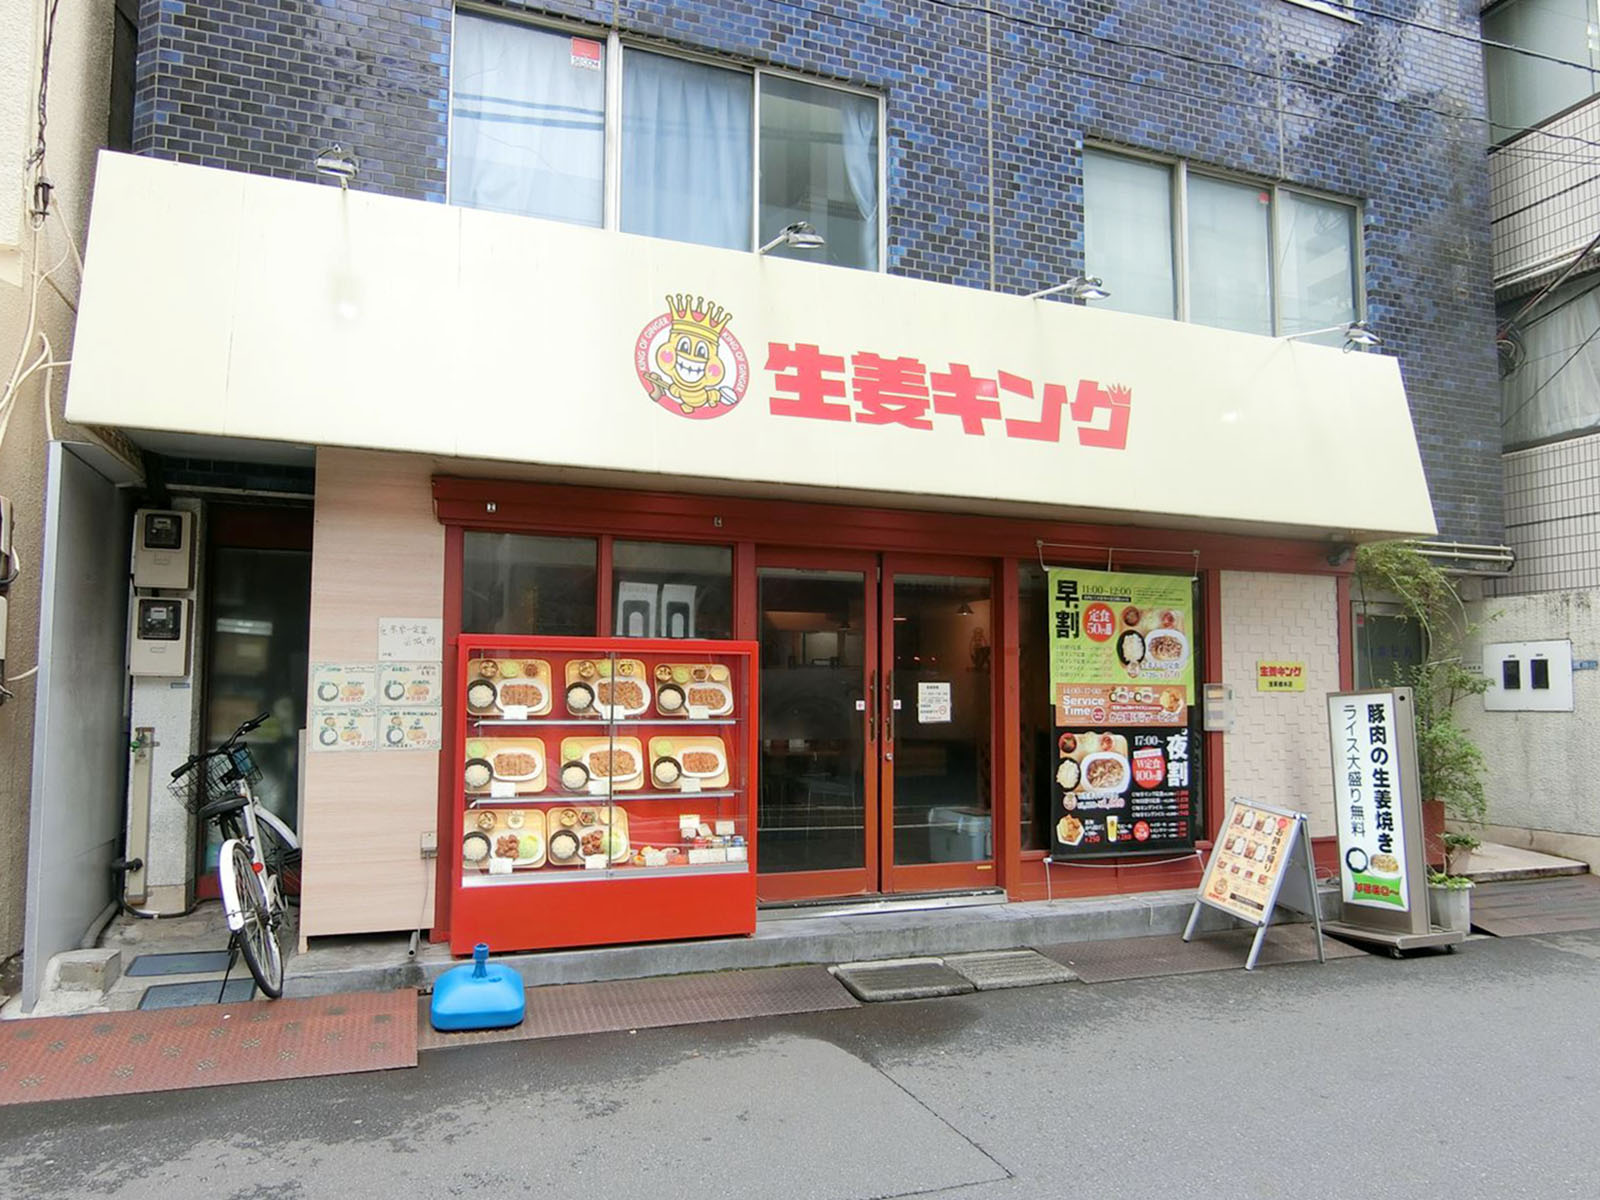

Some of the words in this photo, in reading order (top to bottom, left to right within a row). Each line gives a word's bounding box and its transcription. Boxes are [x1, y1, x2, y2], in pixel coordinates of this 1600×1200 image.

[764, 342, 1132, 450] 生姜キング
[1056, 580, 1080, 639] 早割
[1063, 695, 1105, 706] Service
[1063, 706, 1092, 716] Time
[1166, 733, 1189, 787] 夜割
[1343, 704, 1366, 838] ライス大盛り無料
[1367, 703, 1394, 854] 豚肉の生姜焼き
